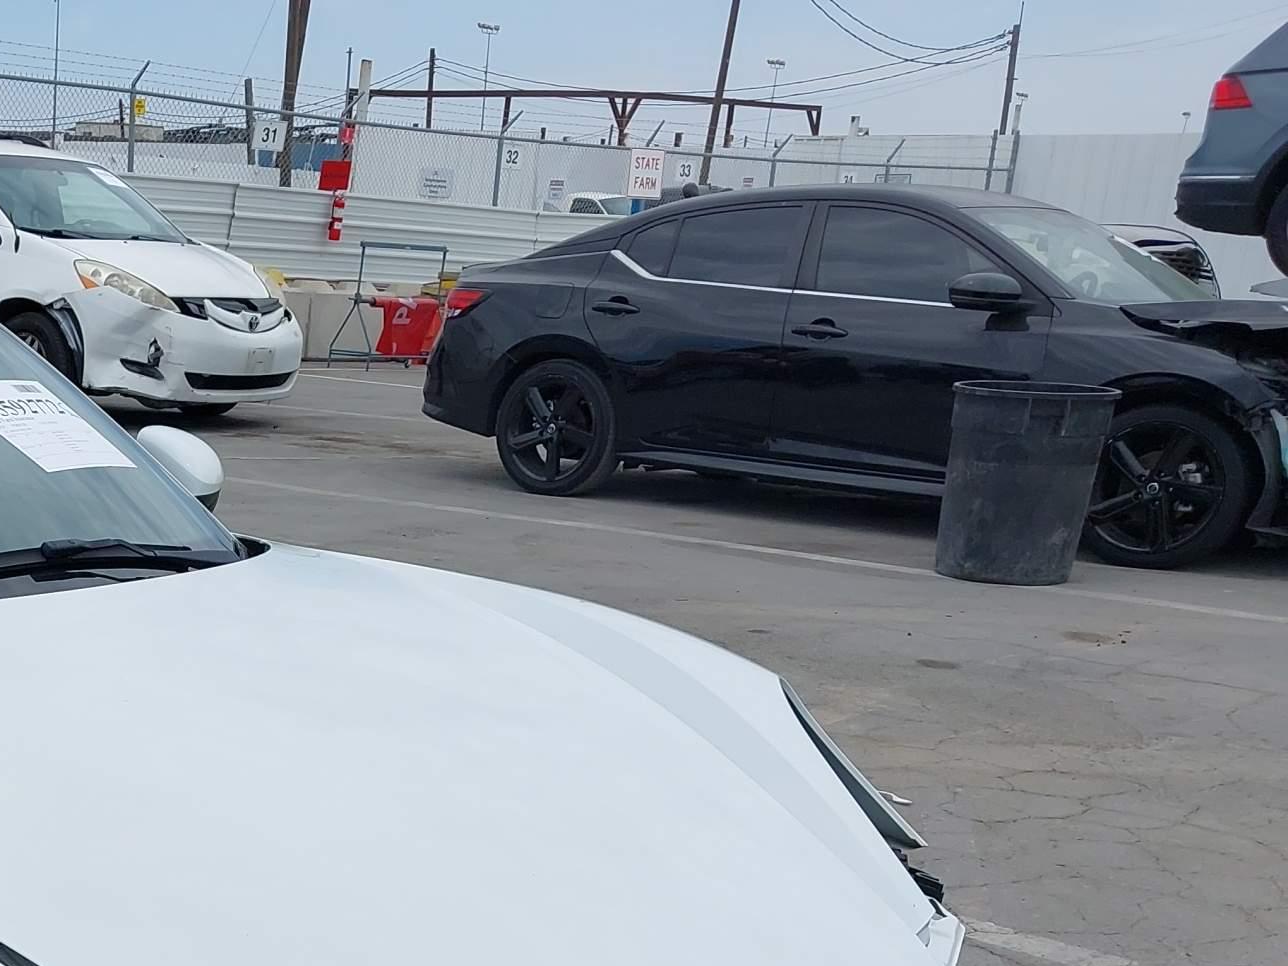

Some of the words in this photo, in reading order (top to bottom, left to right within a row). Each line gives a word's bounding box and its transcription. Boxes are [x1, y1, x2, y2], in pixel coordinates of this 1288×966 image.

[261, 127, 278, 143] 31
[506, 150, 519, 164] 32
[634, 156, 661, 170] STATE
[679, 163, 692, 177] 33
[633, 176, 658, 190] FARM
